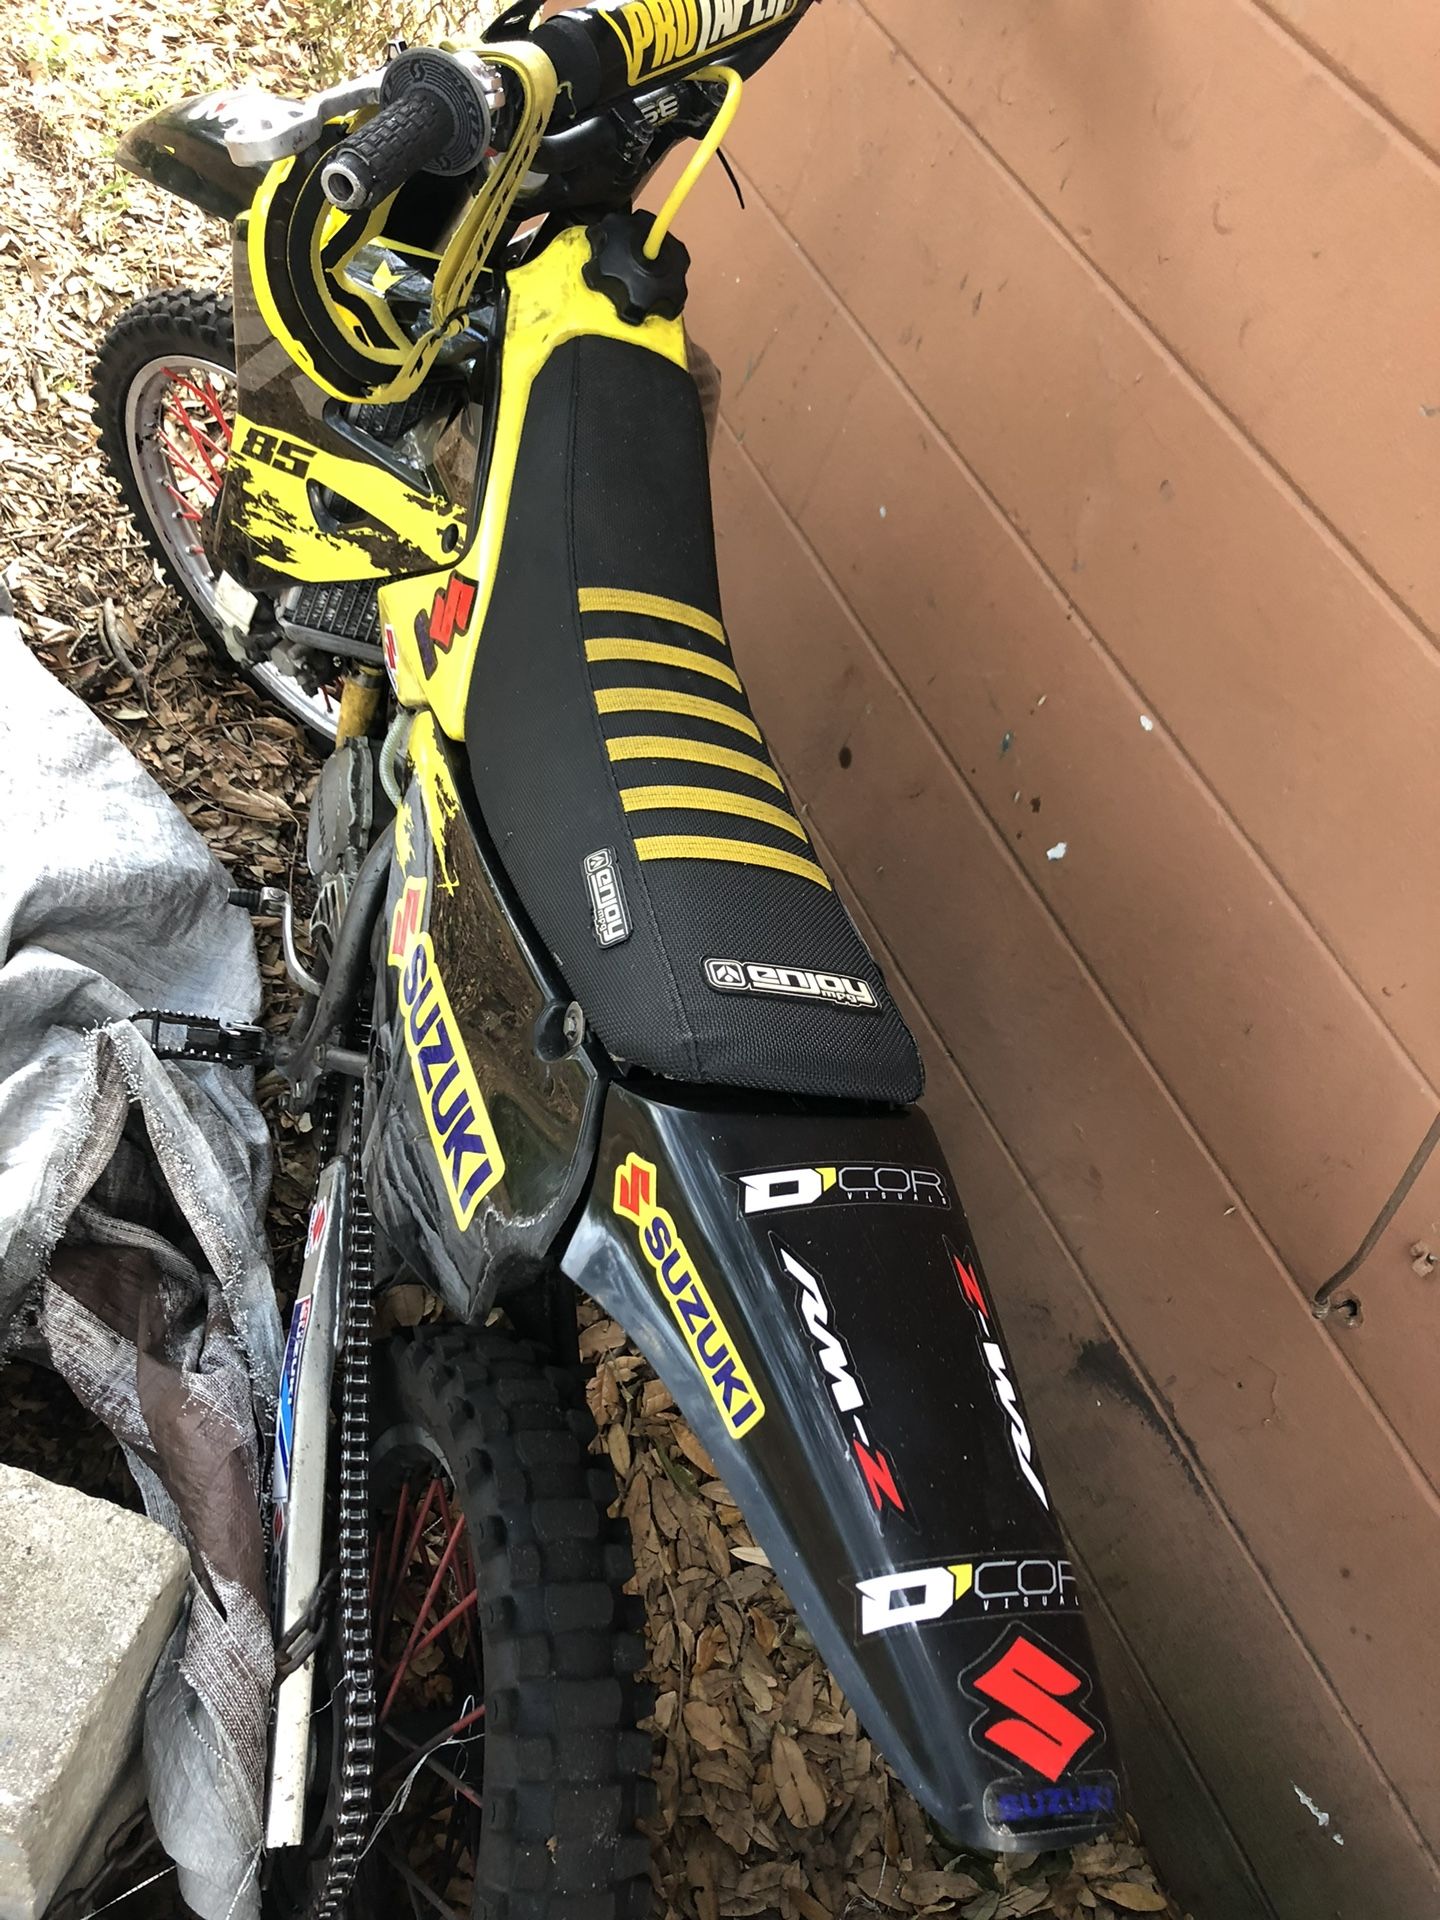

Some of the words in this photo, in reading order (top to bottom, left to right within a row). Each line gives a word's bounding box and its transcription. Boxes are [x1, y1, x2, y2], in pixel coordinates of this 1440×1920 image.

[241, 427, 317, 479] 85
[591, 868, 625, 942] enjoy
[597, 910, 607, 932] mpg
[747, 965, 874, 1004] enjoy
[822, 991, 858, 1004] mpg
[404, 944, 493, 1214] SUZUKI
[739, 1166, 945, 1213] D'COR
[847, 1191, 947, 1205] VISUALS
[645, 1216, 757, 1428] SUZUKI
[983, 1595, 1080, 1611] VISUAL
[997, 1785, 1114, 1822] SUZUKI
